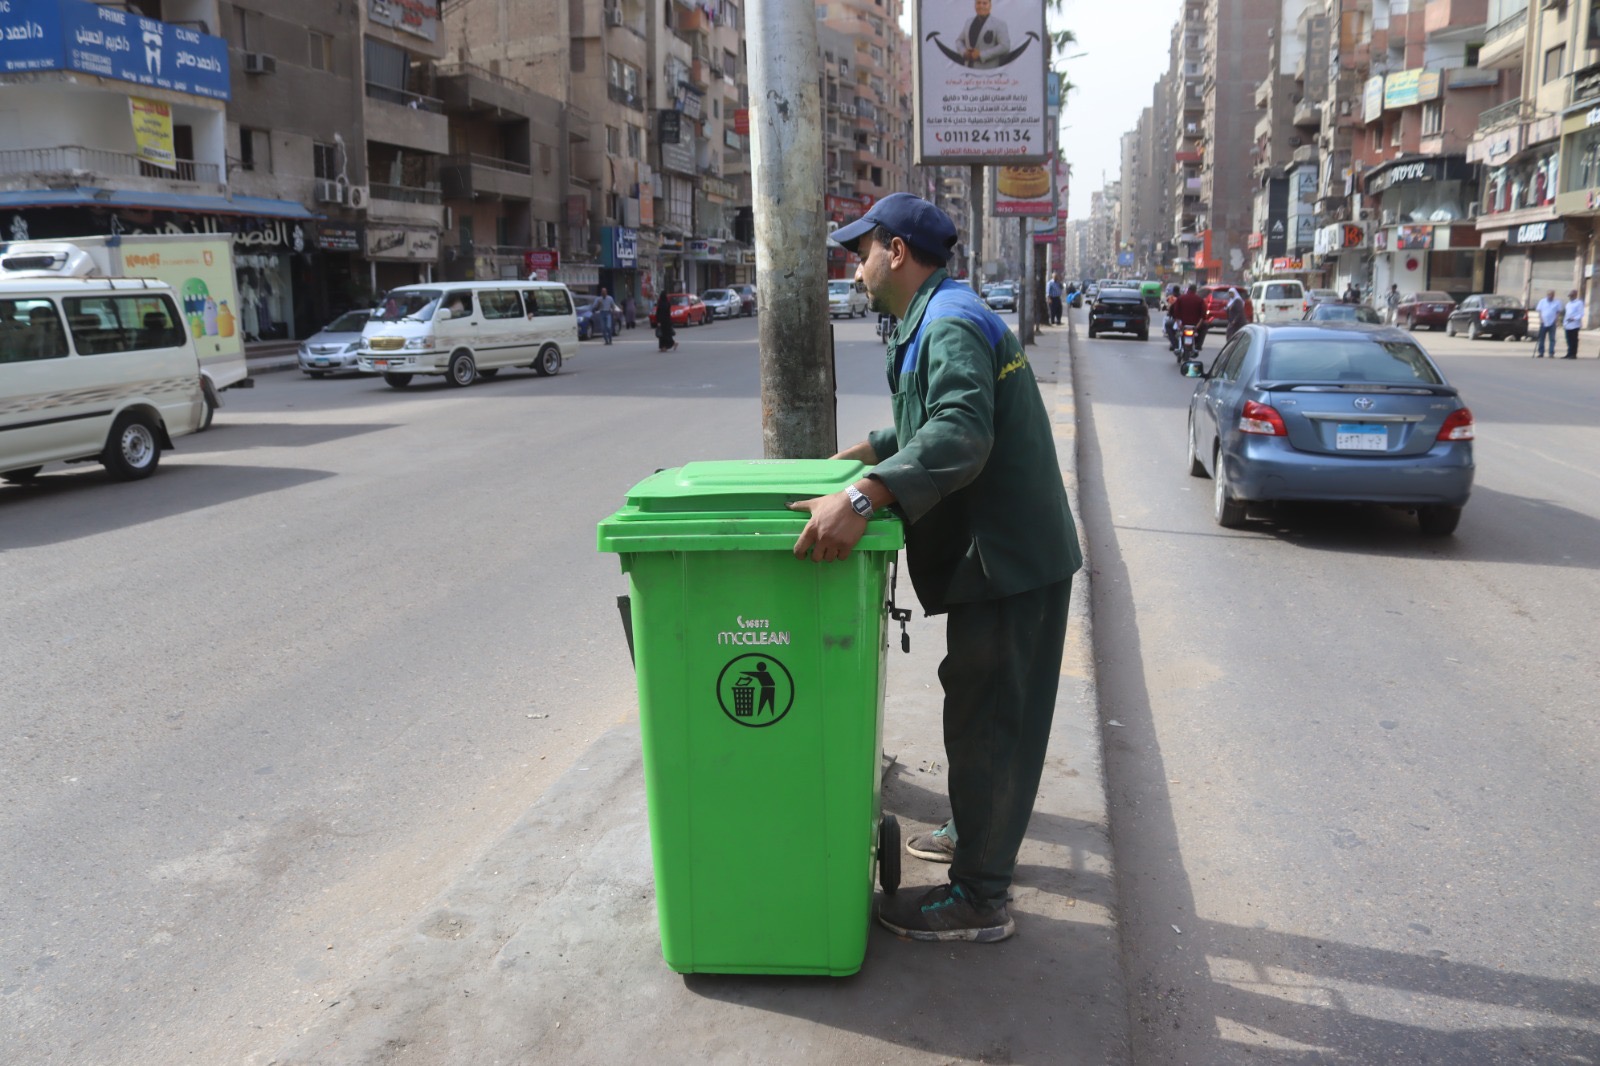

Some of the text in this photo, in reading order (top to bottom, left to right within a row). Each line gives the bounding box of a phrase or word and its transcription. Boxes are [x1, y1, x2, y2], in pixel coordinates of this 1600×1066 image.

[98, 8, 200, 44] PRIME SMILE CLINIC
[944, 129, 1031, 142] 0111 24 111 34
[1391, 161, 1424, 184] NOUR
[126, 253, 160, 268] Kandi
[718, 631, 790, 645] MCCLEAN
